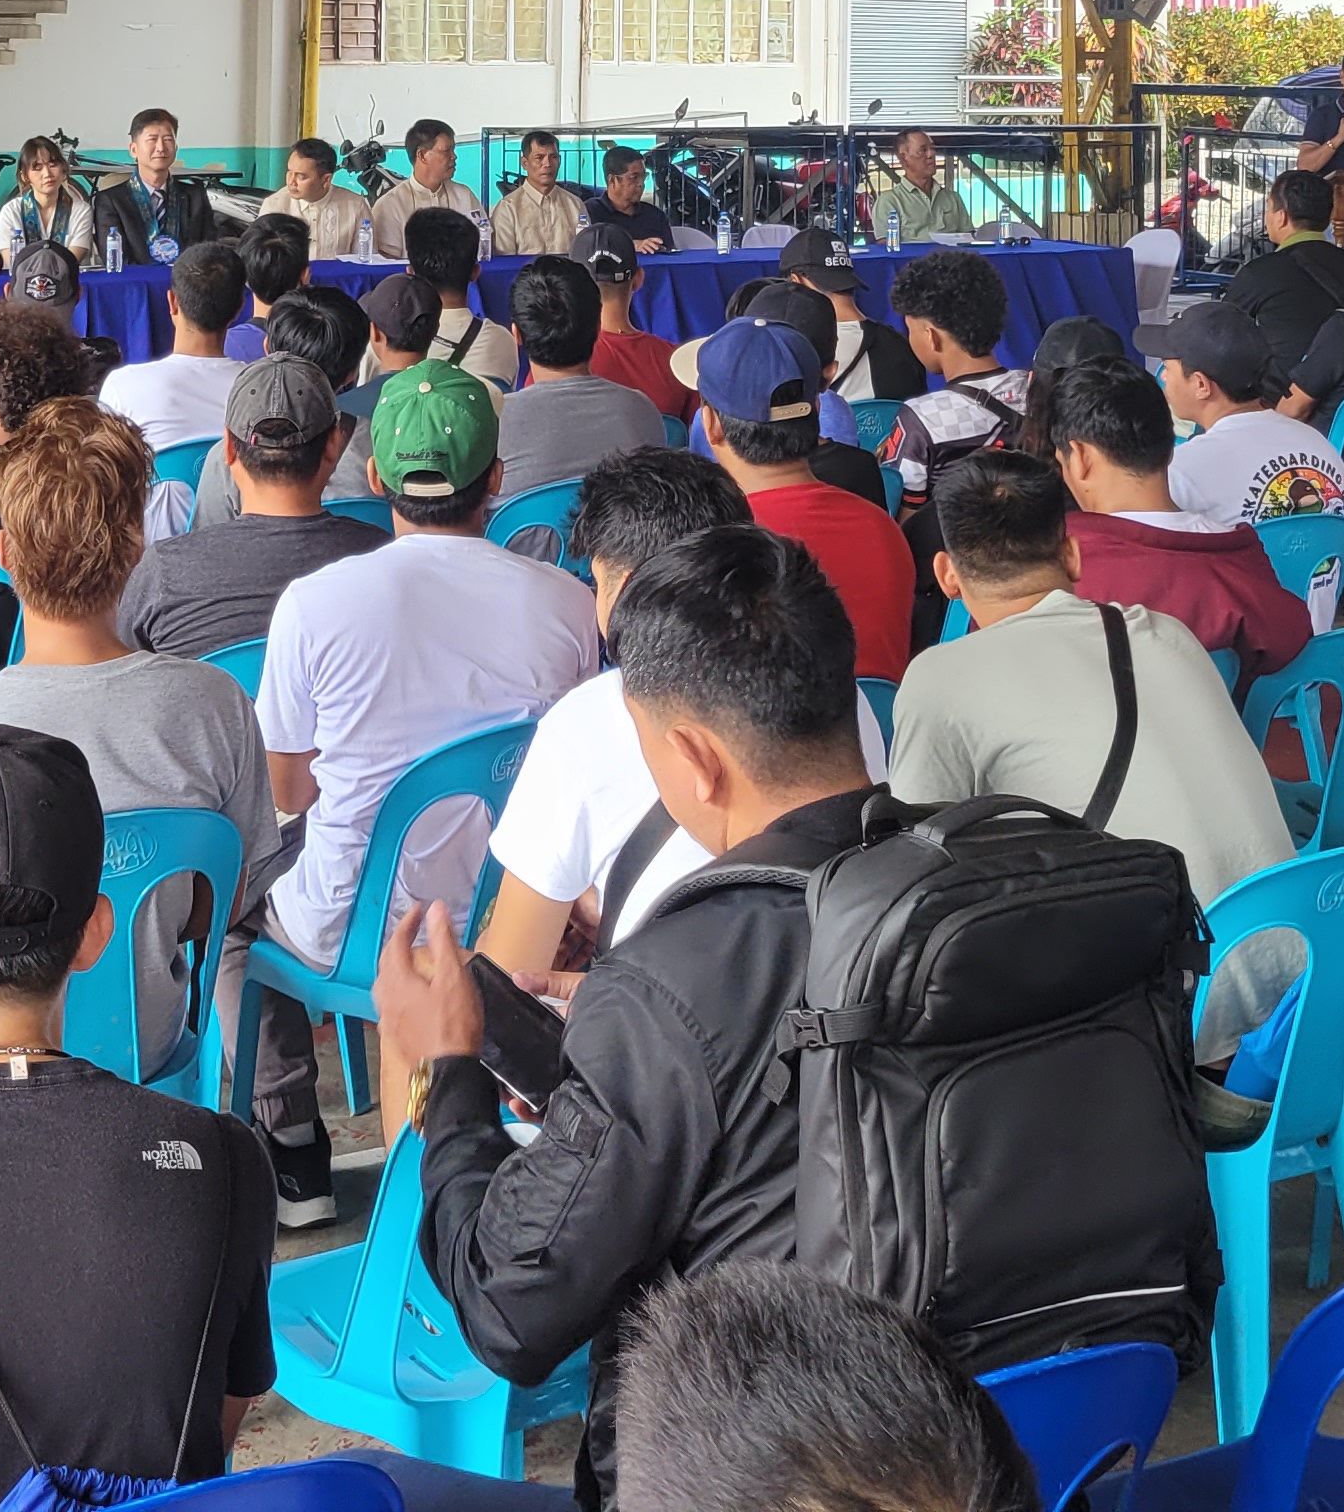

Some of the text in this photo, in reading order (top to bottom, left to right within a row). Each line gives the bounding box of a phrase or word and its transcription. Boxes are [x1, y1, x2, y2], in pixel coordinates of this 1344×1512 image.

[158, 1140, 181, 1151] THE
[141, 1149, 183, 1162] NORTH
[155, 1159, 185, 1170] FACE
